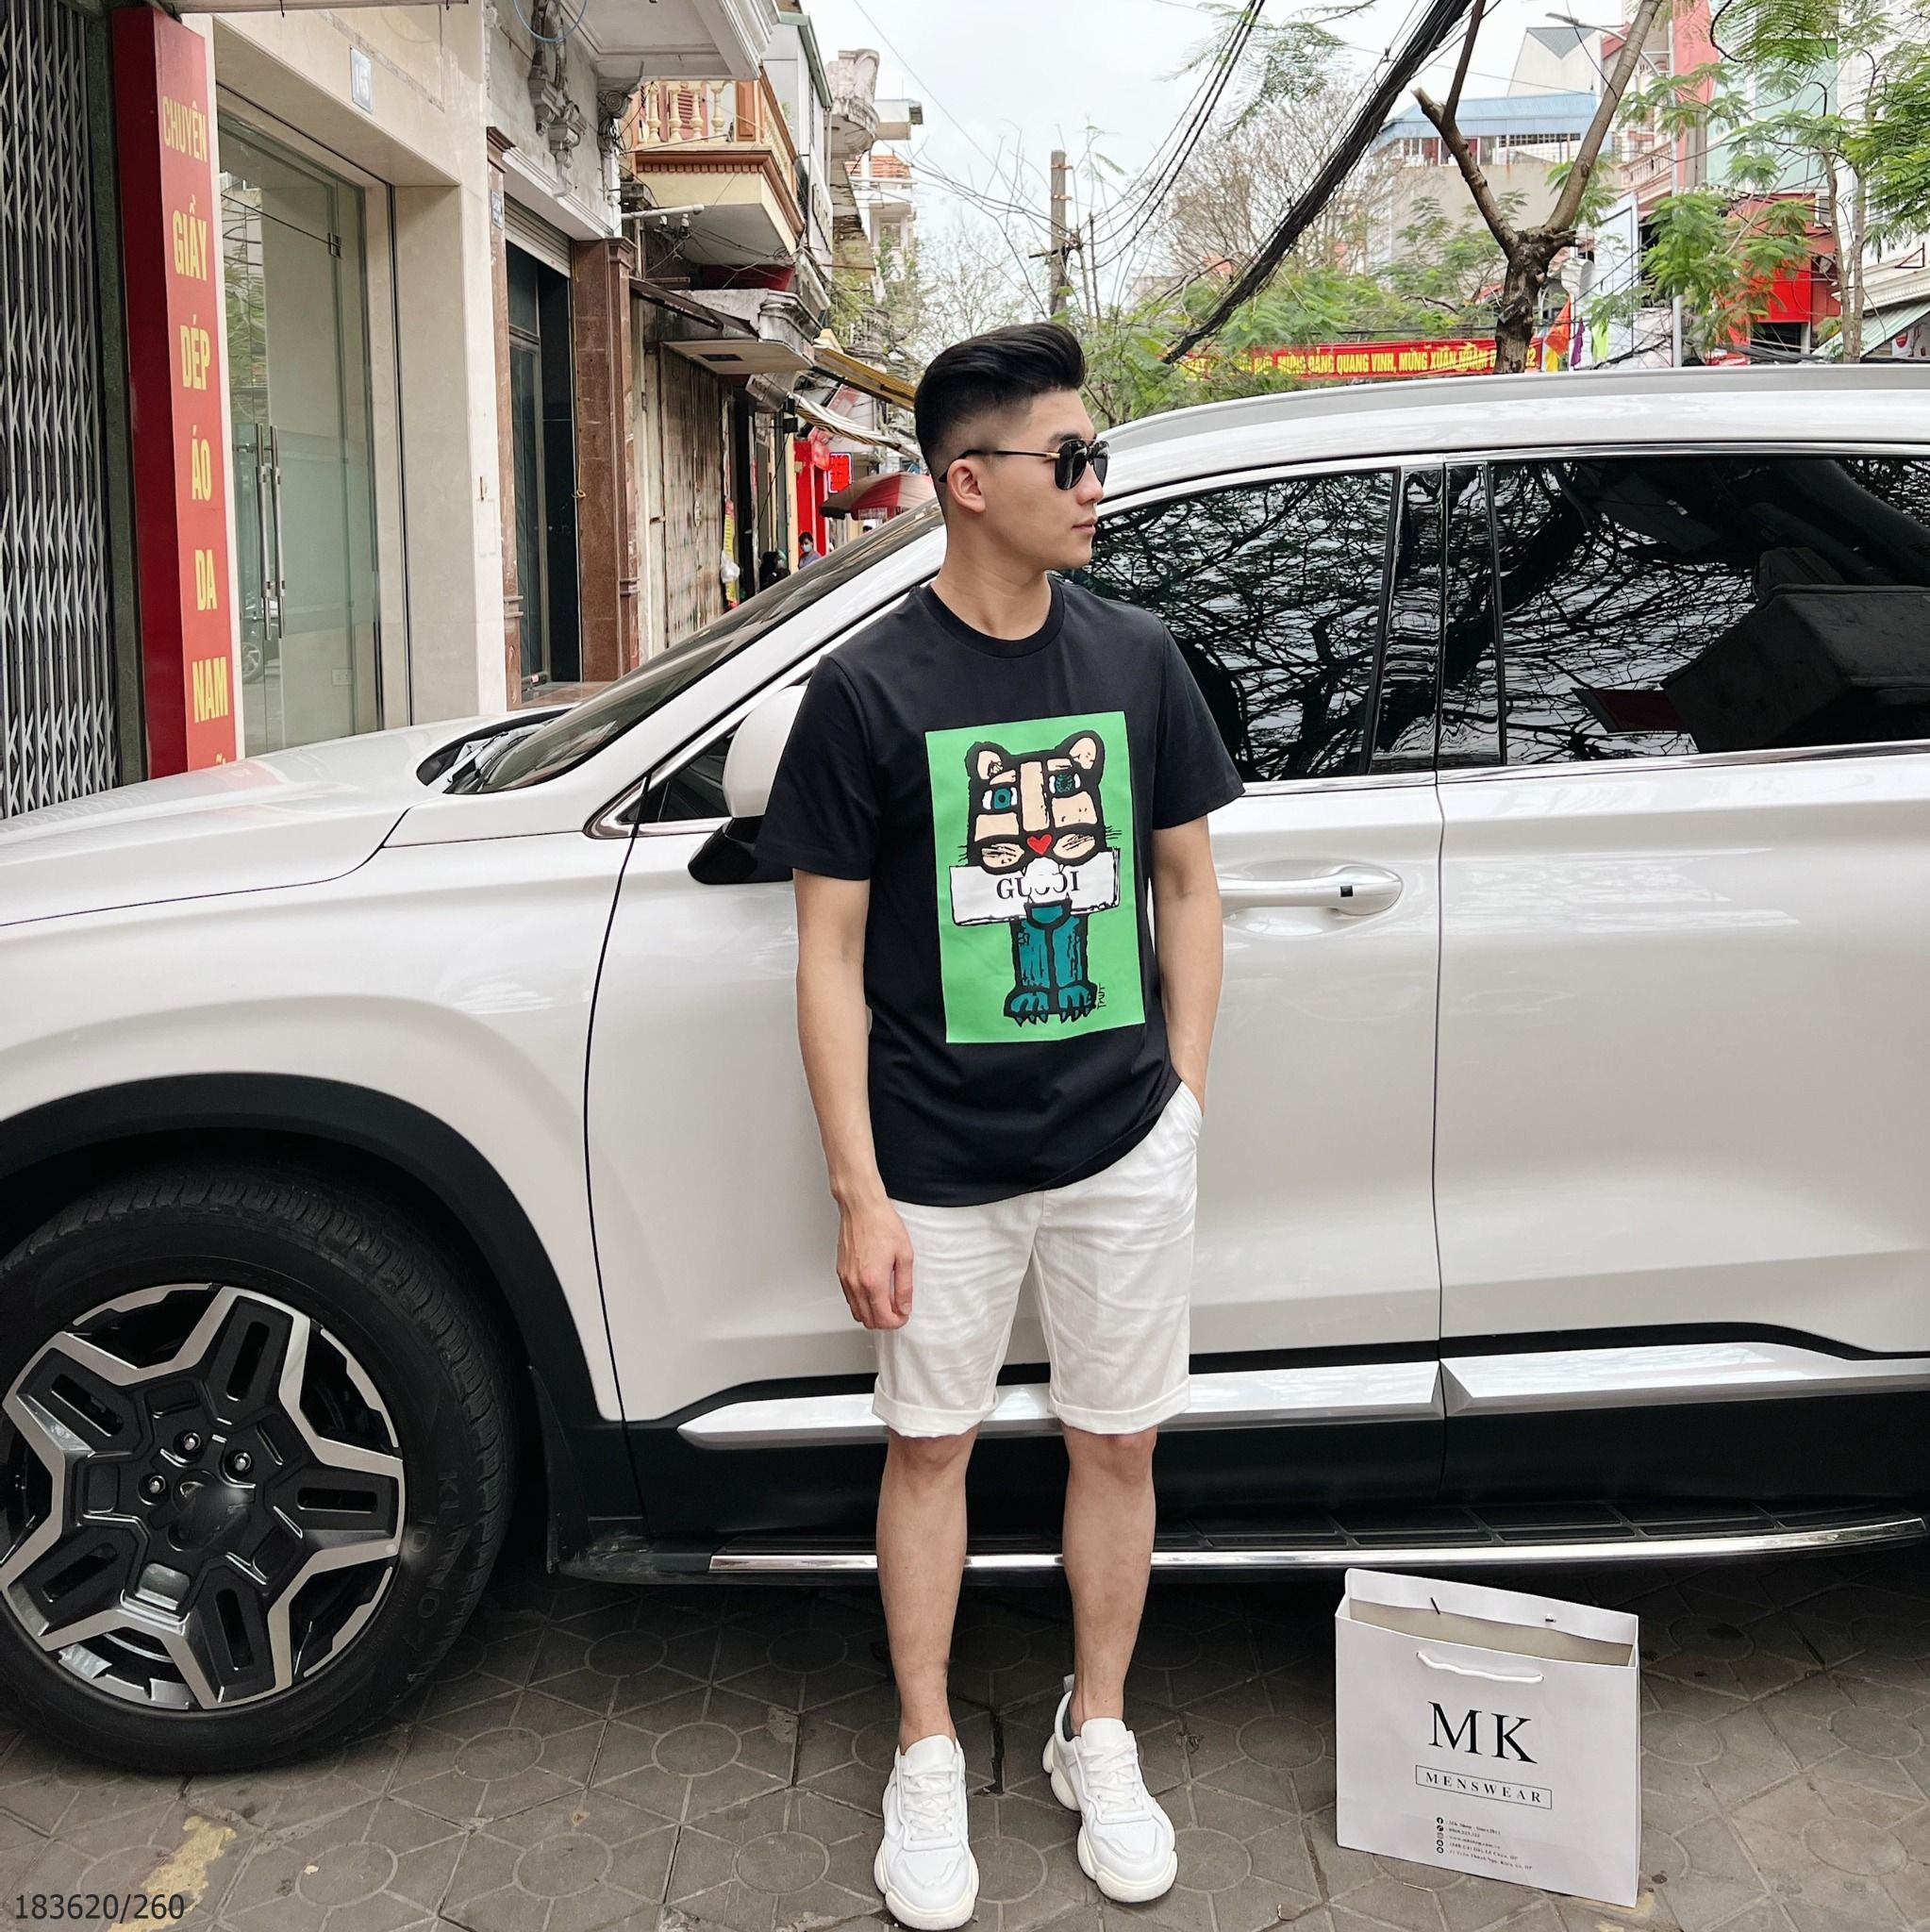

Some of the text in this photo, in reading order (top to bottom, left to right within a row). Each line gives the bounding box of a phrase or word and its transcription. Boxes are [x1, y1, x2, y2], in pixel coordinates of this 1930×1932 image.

[162, 96, 208, 162] CHUYÊN
[179, 314, 210, 391] DÉP
[1336, 353, 1369, 375] QUANG
[1372, 353, 1396, 374] VINH,
[191, 425, 212, 502] ÁO
[194, 549, 218, 611] DA
[191, 657, 229, 724] NAM
[1427, 1700, 1539, 1764] MK
[1425, 1772, 1540, 1803] MENSWEAR
